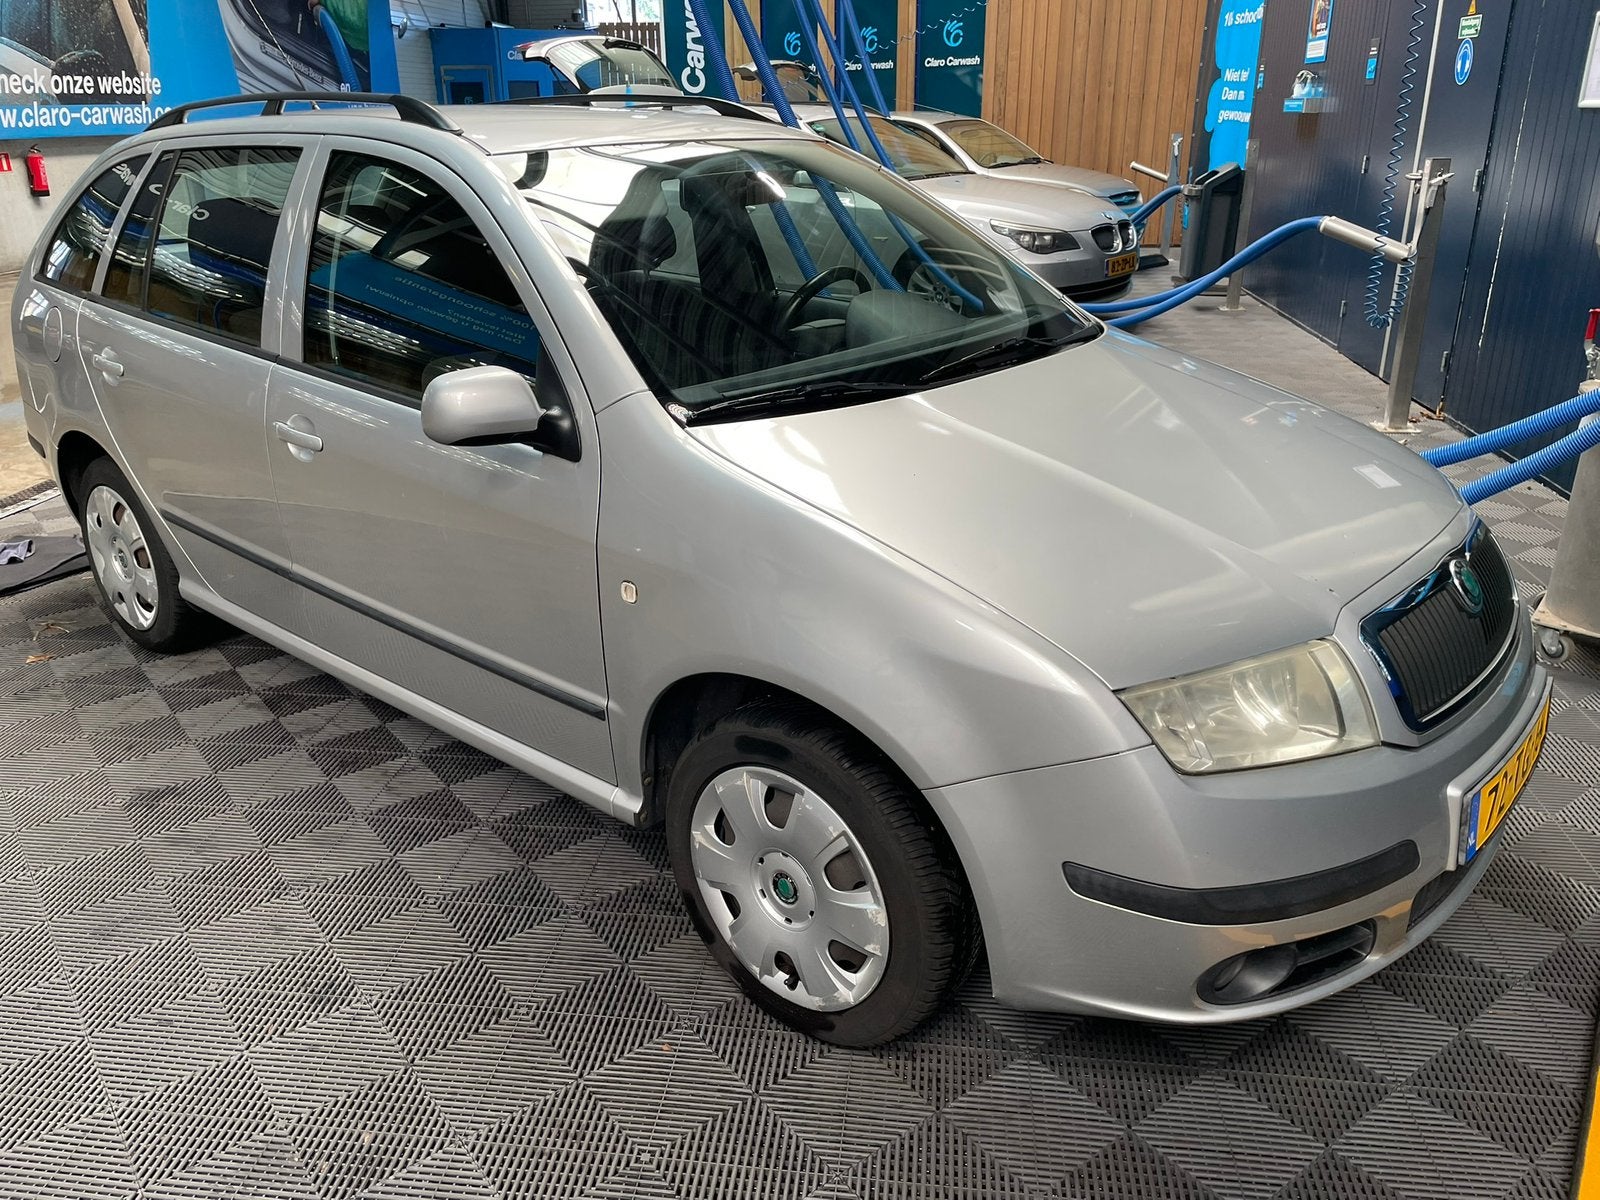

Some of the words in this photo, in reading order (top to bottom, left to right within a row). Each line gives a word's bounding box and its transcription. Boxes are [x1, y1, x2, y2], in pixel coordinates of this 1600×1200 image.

[681, 0, 706, 94] Carw
[870, 59, 894, 70] rwash
[924, 56, 946, 68] Claro
[946, 54, 981, 67] Carwash
[50, 72, 95, 95] onze
[97, 70, 162, 96] website
